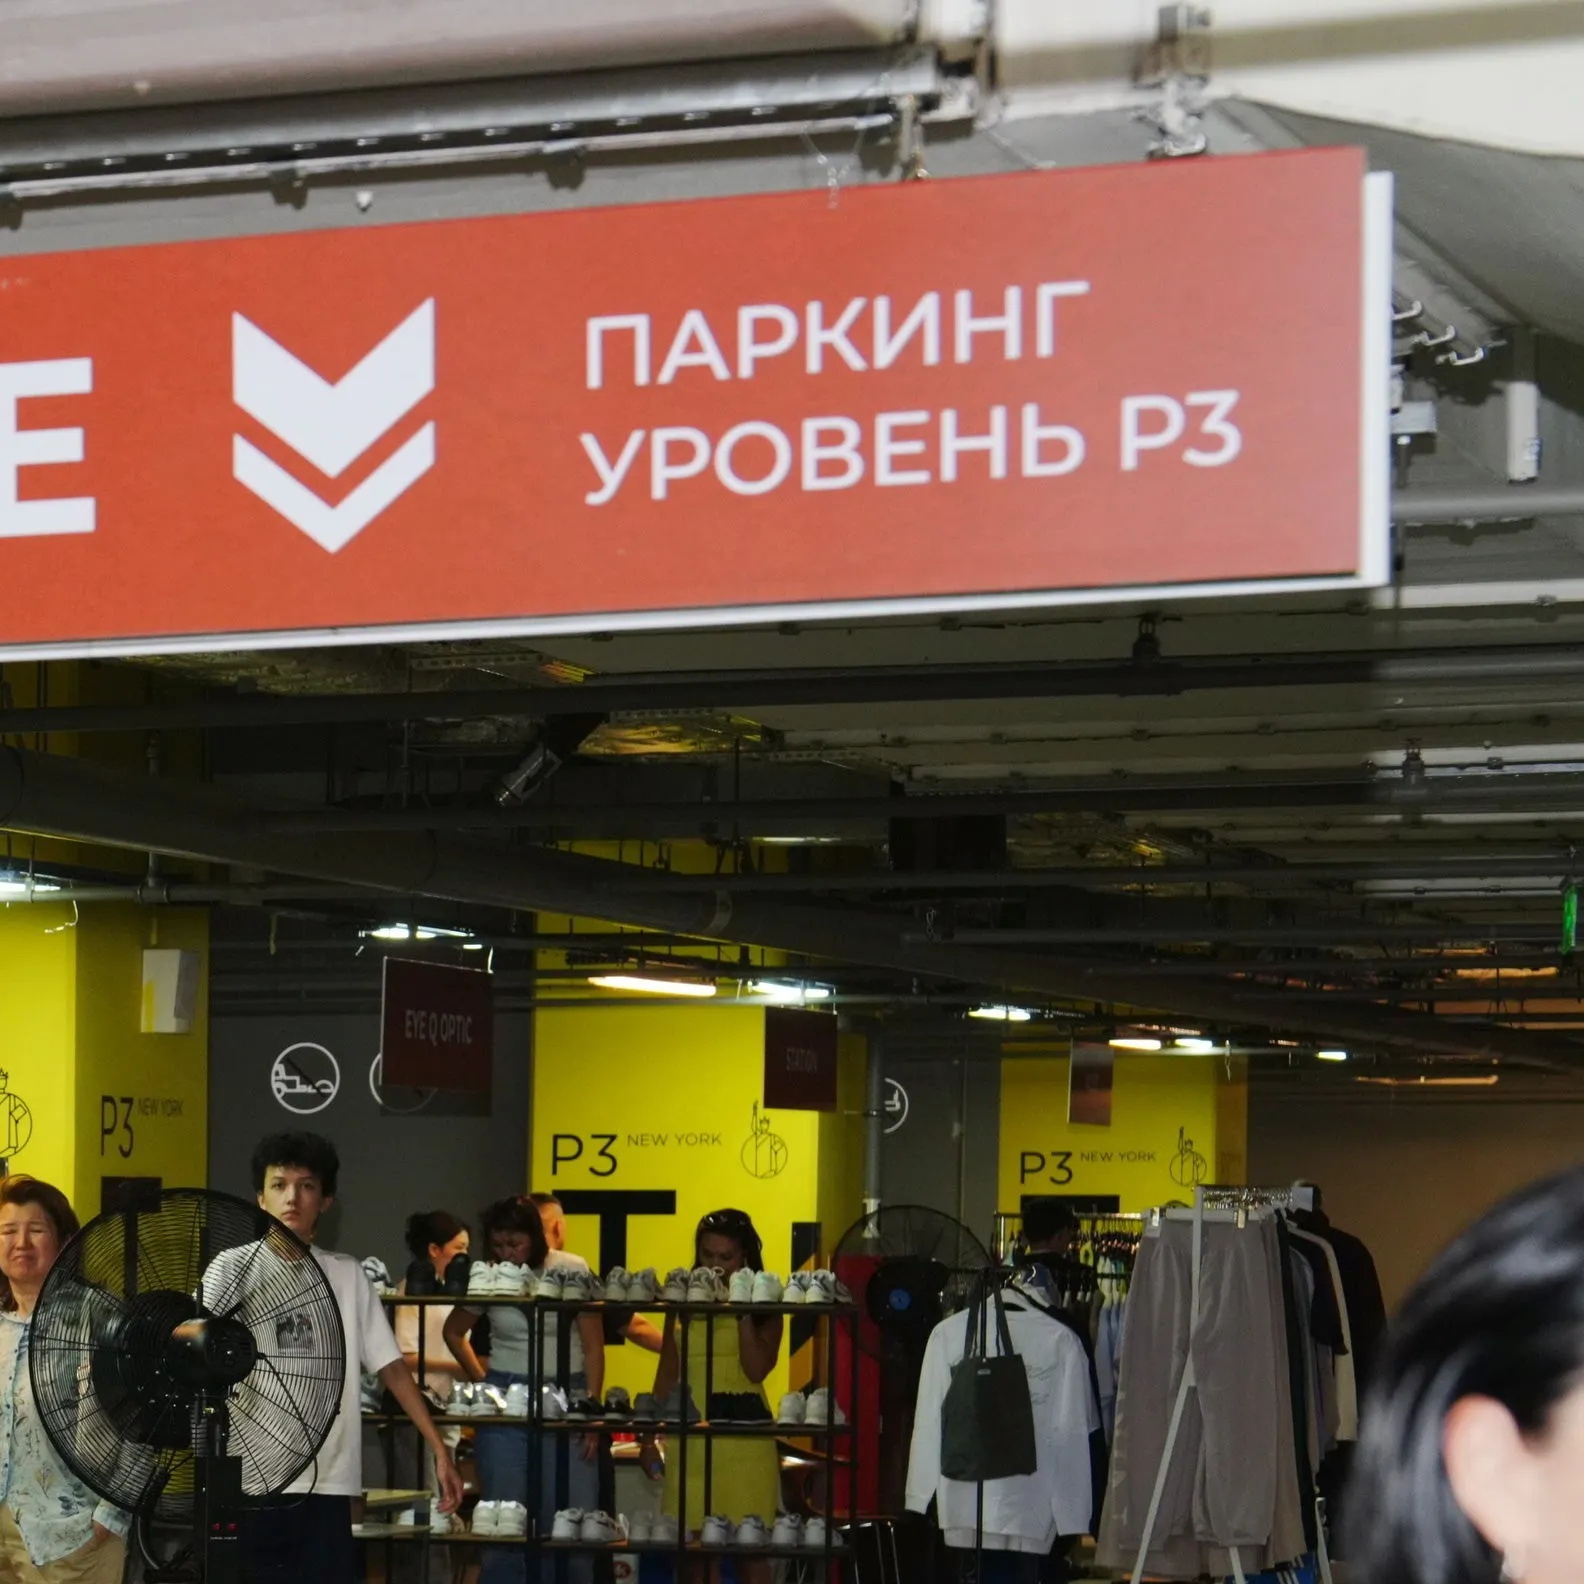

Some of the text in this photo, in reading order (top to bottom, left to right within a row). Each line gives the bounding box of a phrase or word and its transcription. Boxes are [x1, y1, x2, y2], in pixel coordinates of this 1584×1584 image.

[585, 279, 1091, 390] ПАРКИНГ
[579, 401, 1088, 507] УРОВЕНЬ
[405, 1009, 427, 1040] EYE
[440, 1012, 473, 1045] OPTIC
[100, 1095, 135, 1159] P3
[551, 1132, 722, 1177] P3 NEW YORK
[1019, 1150, 1157, 1186] P3 NEW YORK
